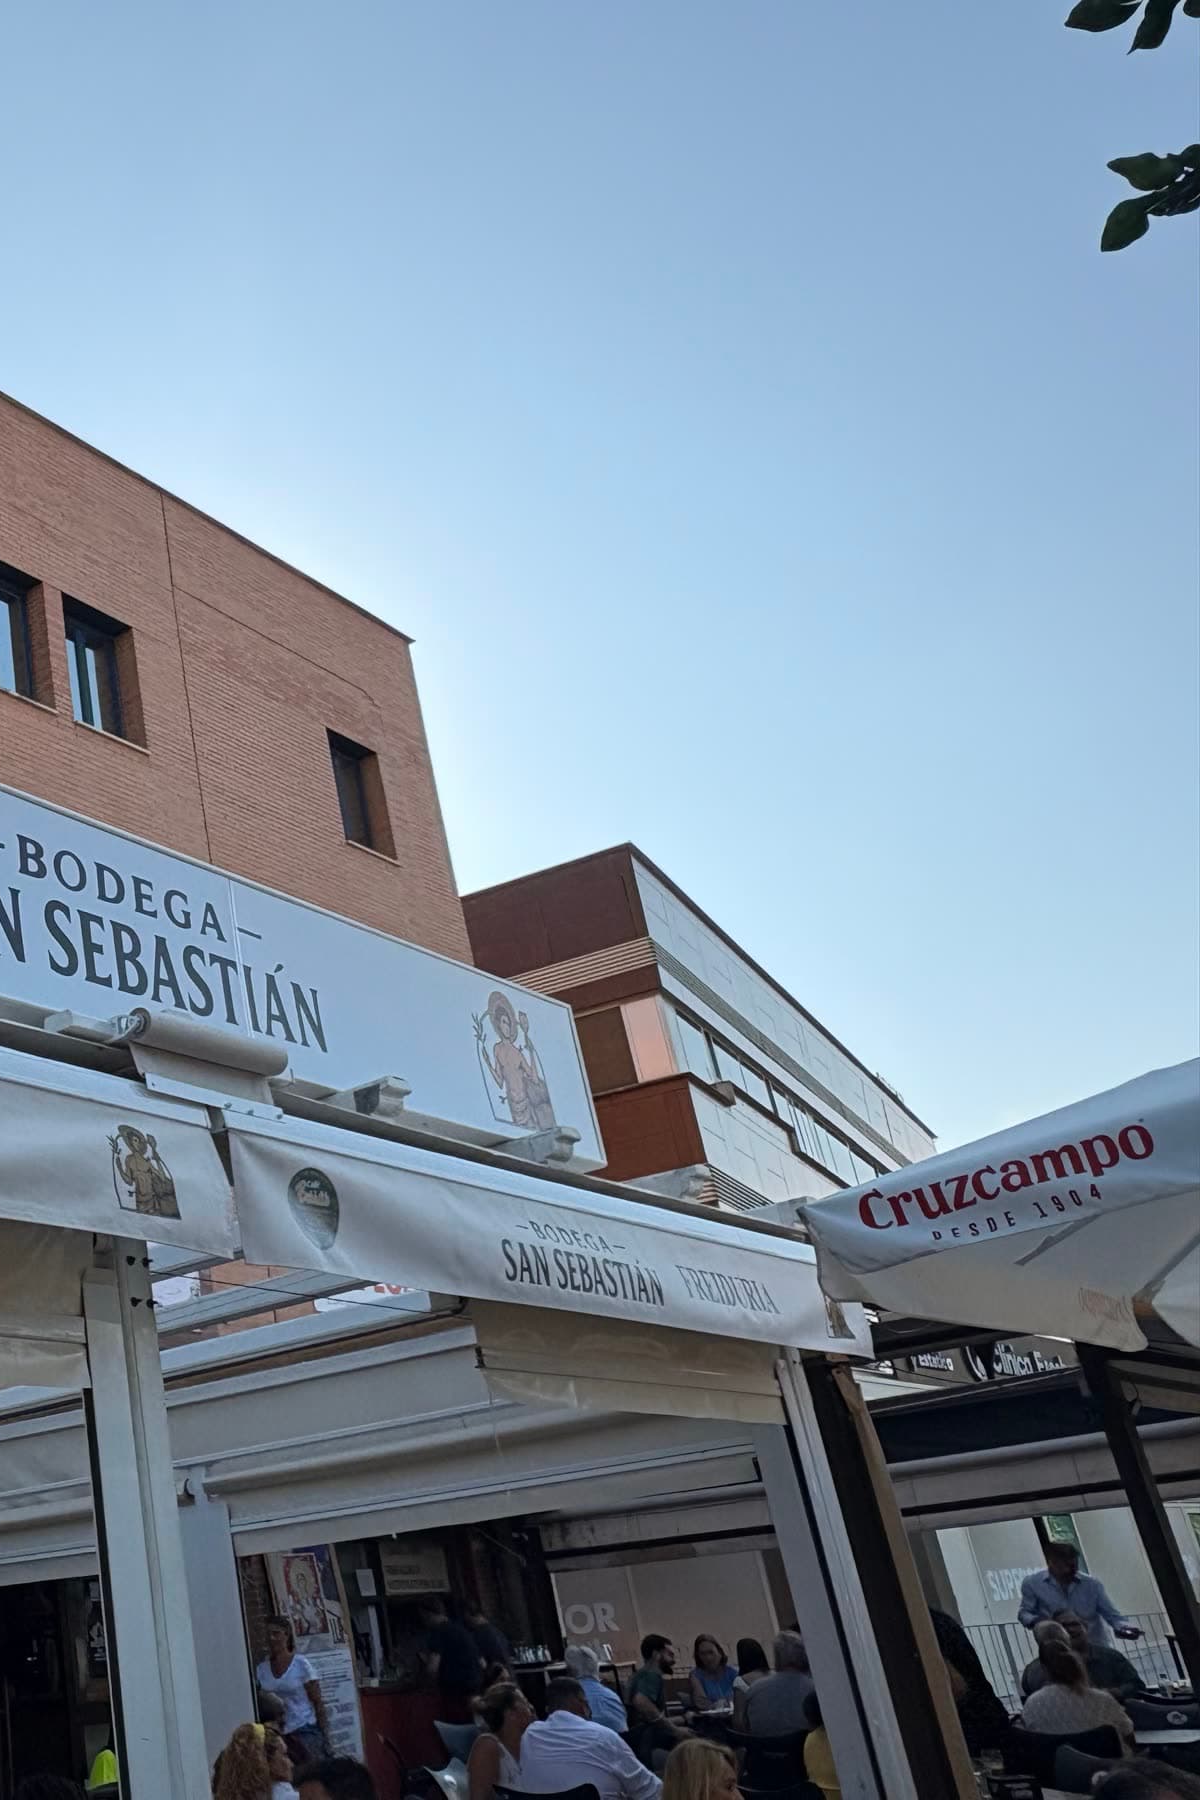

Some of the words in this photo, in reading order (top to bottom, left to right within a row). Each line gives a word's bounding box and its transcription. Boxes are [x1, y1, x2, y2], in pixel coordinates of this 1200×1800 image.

[16, 833, 228, 943] BODEGA
[43, 899, 328, 1054] SEBASTIÁN
[858, 1124, 1155, 1231] Cruzcampo
[529, 1220, 615, 1255] BODEGA
[931, 1210, 1017, 1242] DESDE
[1032, 1183, 1103, 1219] 1904
[501, 1238, 551, 1288] SAN
[553, 1247, 666, 1307] SEBASTIÁN
[675, 1264, 781, 1315] FREIDURIA
